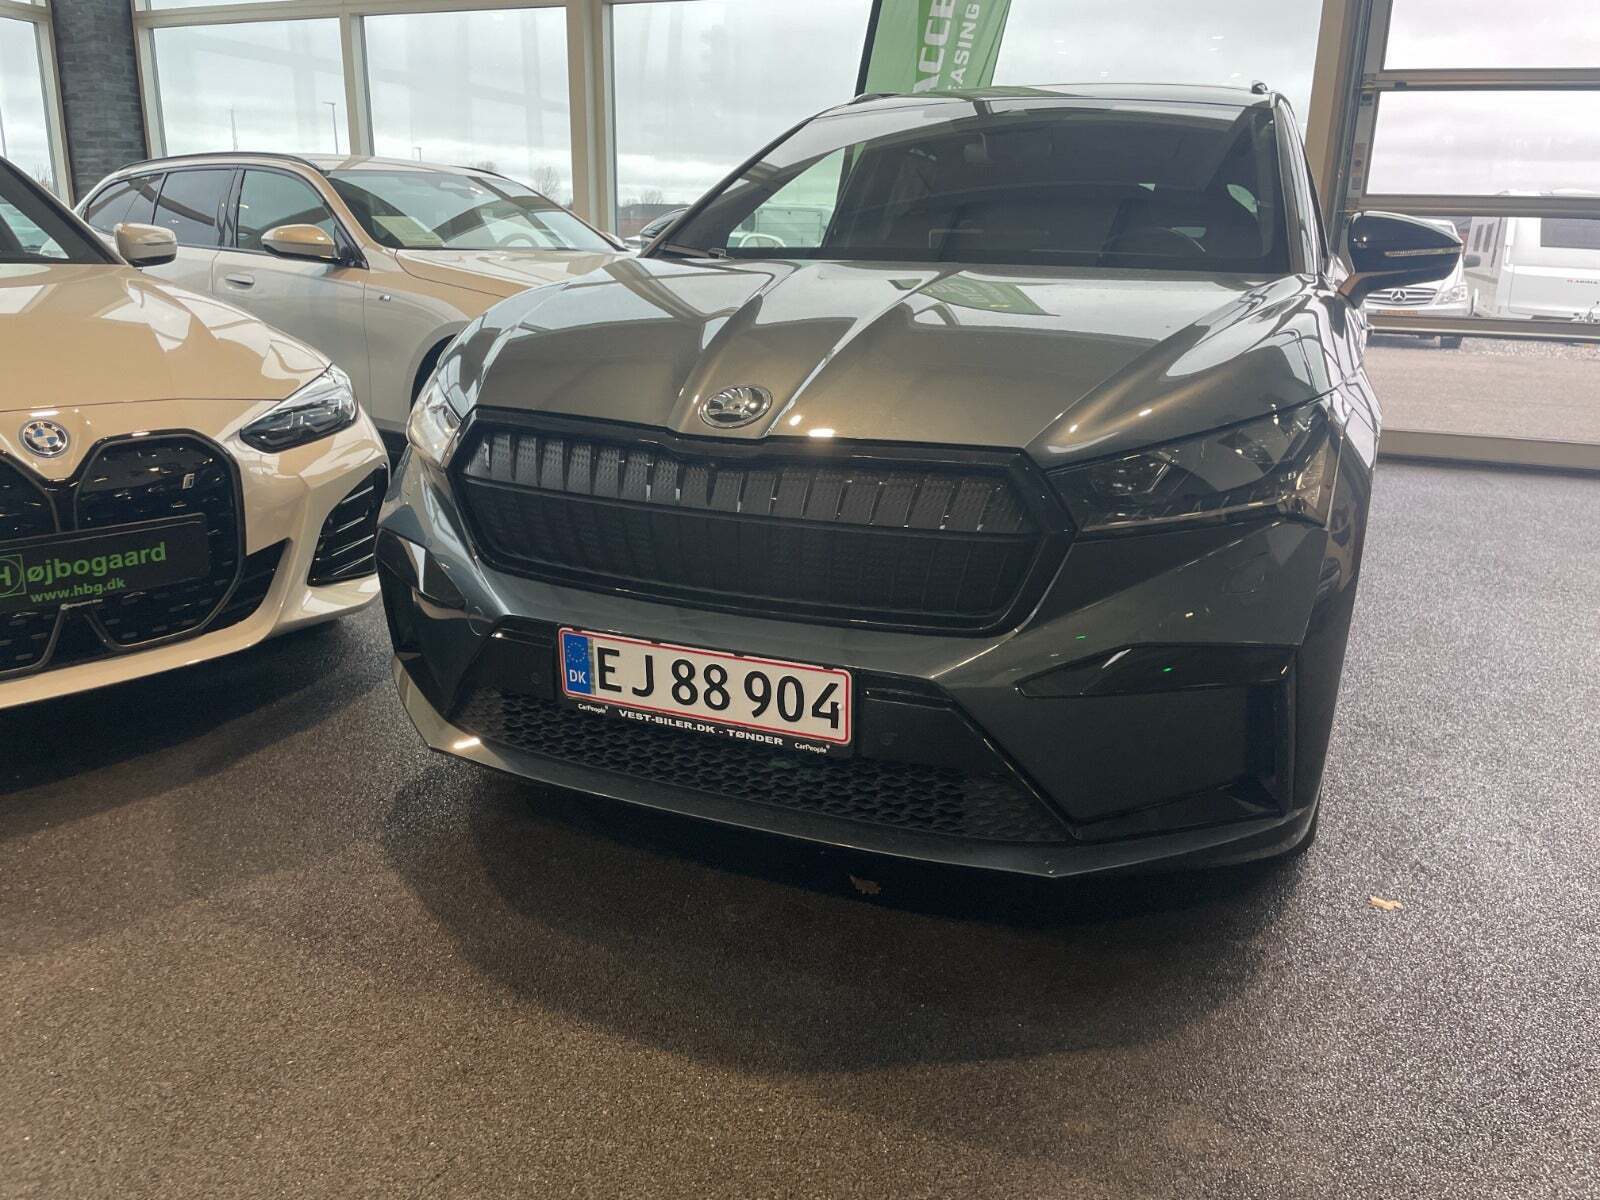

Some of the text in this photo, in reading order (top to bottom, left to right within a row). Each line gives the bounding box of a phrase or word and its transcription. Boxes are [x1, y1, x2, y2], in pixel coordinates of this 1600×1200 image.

[30, 577, 126, 602] www.hbg.dk
[569, 669, 586, 685] DK
[597, 646, 839, 729] EJ 88 904
[618, 709, 716, 734] VEST-BILER.DK
[726, 728, 784, 746] TØNDER
